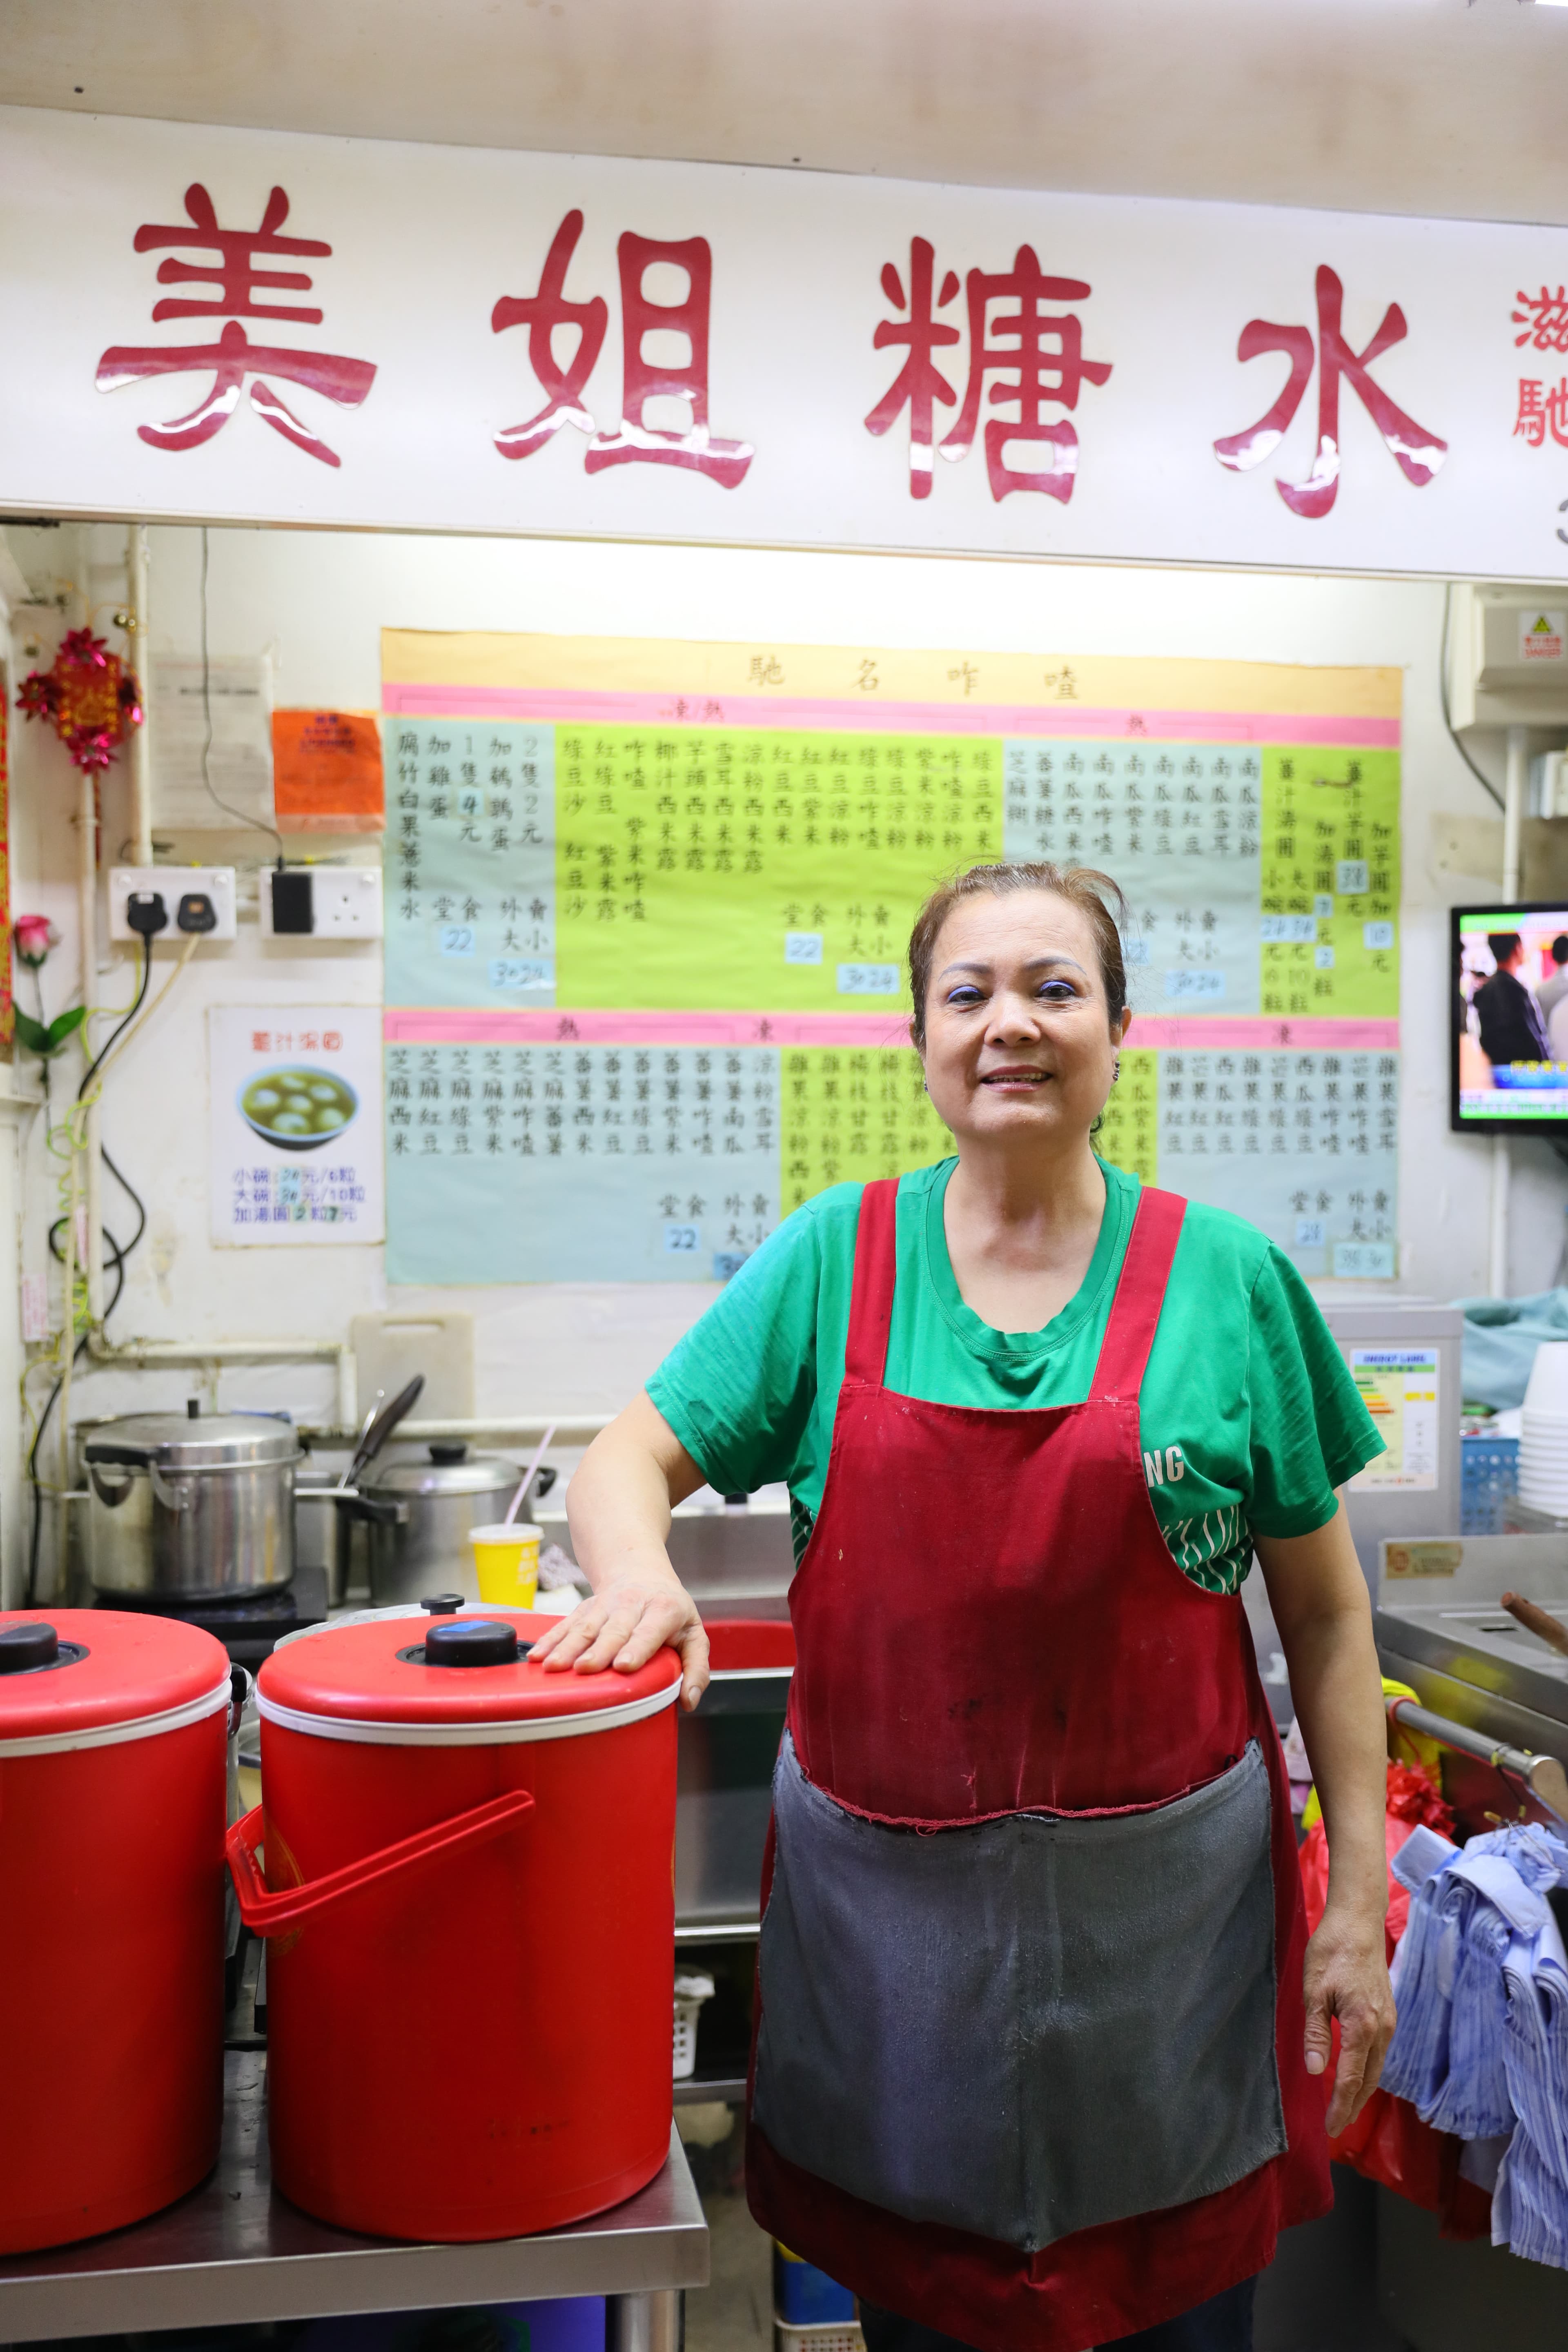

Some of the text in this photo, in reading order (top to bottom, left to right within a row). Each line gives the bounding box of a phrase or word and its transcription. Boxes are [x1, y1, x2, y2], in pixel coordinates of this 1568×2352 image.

[95, 183, 1448, 519] 美姐糖水
[746, 654, 1079, 701] 馳名咋喳
[426, 733, 452, 820] 加雞蛋
[431, 894, 548, 924] 堂食 外賣
[781, 901, 891, 928] 堂食 外賣
[445, 928, 472, 951] 22
[500, 927, 549, 952] 大小
[790, 940, 818, 958] 22
[848, 932, 893, 957] 大小
[657, 1191, 770, 1219] 堂食 外賣
[669, 1227, 696, 1250] 22
[1144, 1446, 1184, 1488] NG
